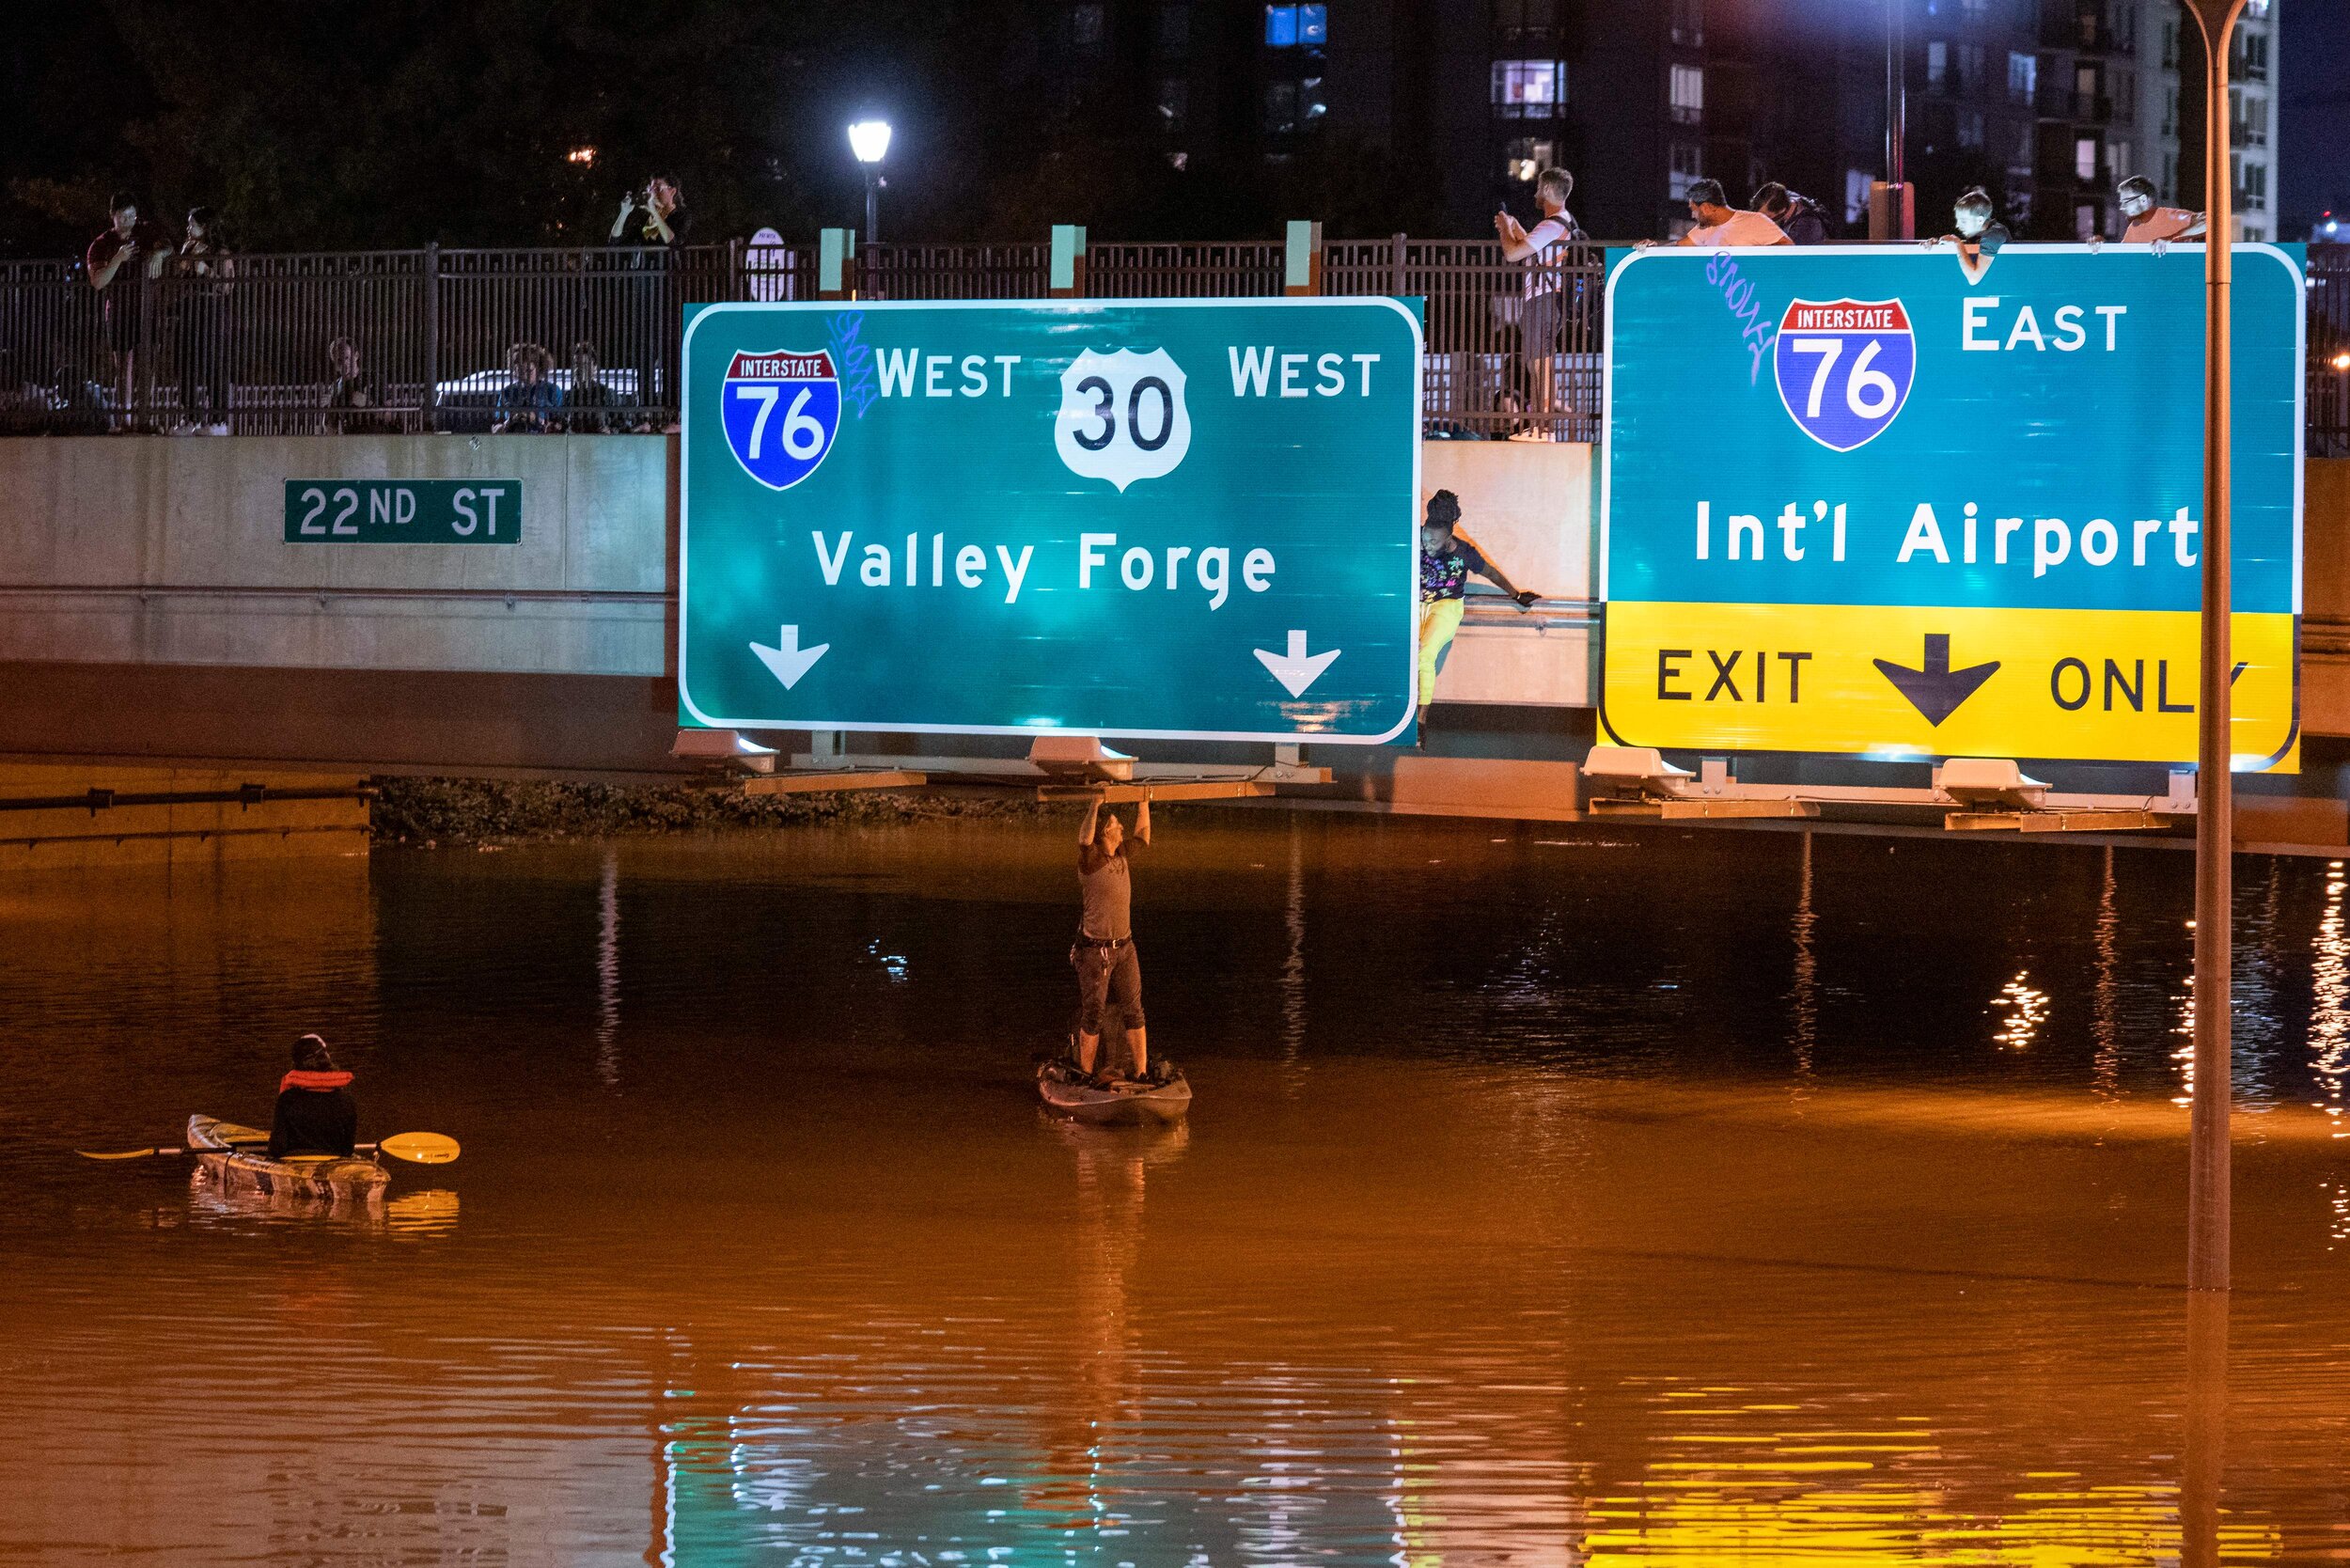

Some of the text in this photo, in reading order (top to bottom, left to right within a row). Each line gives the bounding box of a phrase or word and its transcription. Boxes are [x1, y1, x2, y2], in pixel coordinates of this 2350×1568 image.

[1797, 309, 1893, 329] INTERSTATE
[1962, 297, 2127, 352] EAST
[741, 359, 822, 377] INTERSTATE
[875, 348, 1021, 397] WEST
[1228, 346, 1381, 398] WEST
[1793, 338, 1897, 419] 76
[736, 386, 824, 461] 76
[1073, 376, 1174, 451] 30
[451, 487, 505, 536] ST
[1896, 502, 2199, 579] Airport
[812, 531, 1276, 611] Valley Forge
[1657, 650, 1812, 703] EXIT
